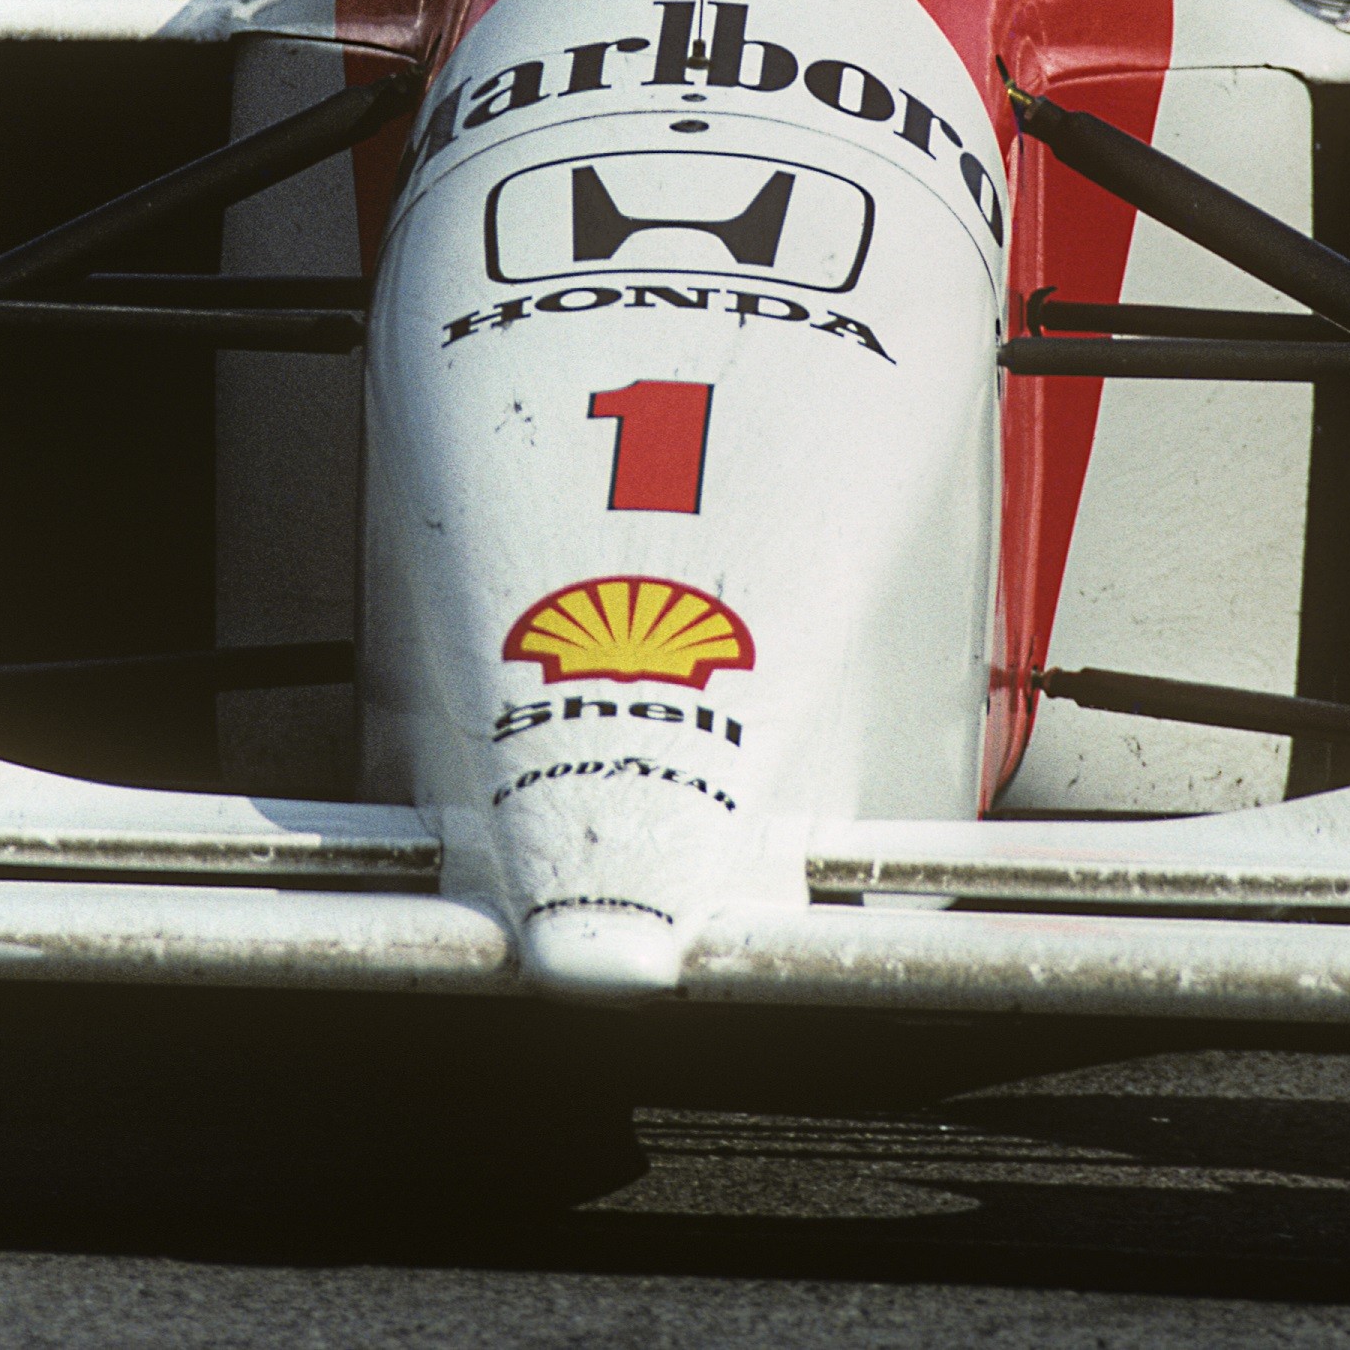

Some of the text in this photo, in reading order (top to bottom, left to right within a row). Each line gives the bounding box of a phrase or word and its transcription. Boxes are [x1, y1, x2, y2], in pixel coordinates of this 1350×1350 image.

[441, 286, 897, 365] HONDA
[587, 379, 716, 516] 1
[493, 696, 744, 748] Shell
[493, 757, 736, 812] GOODYEAR
